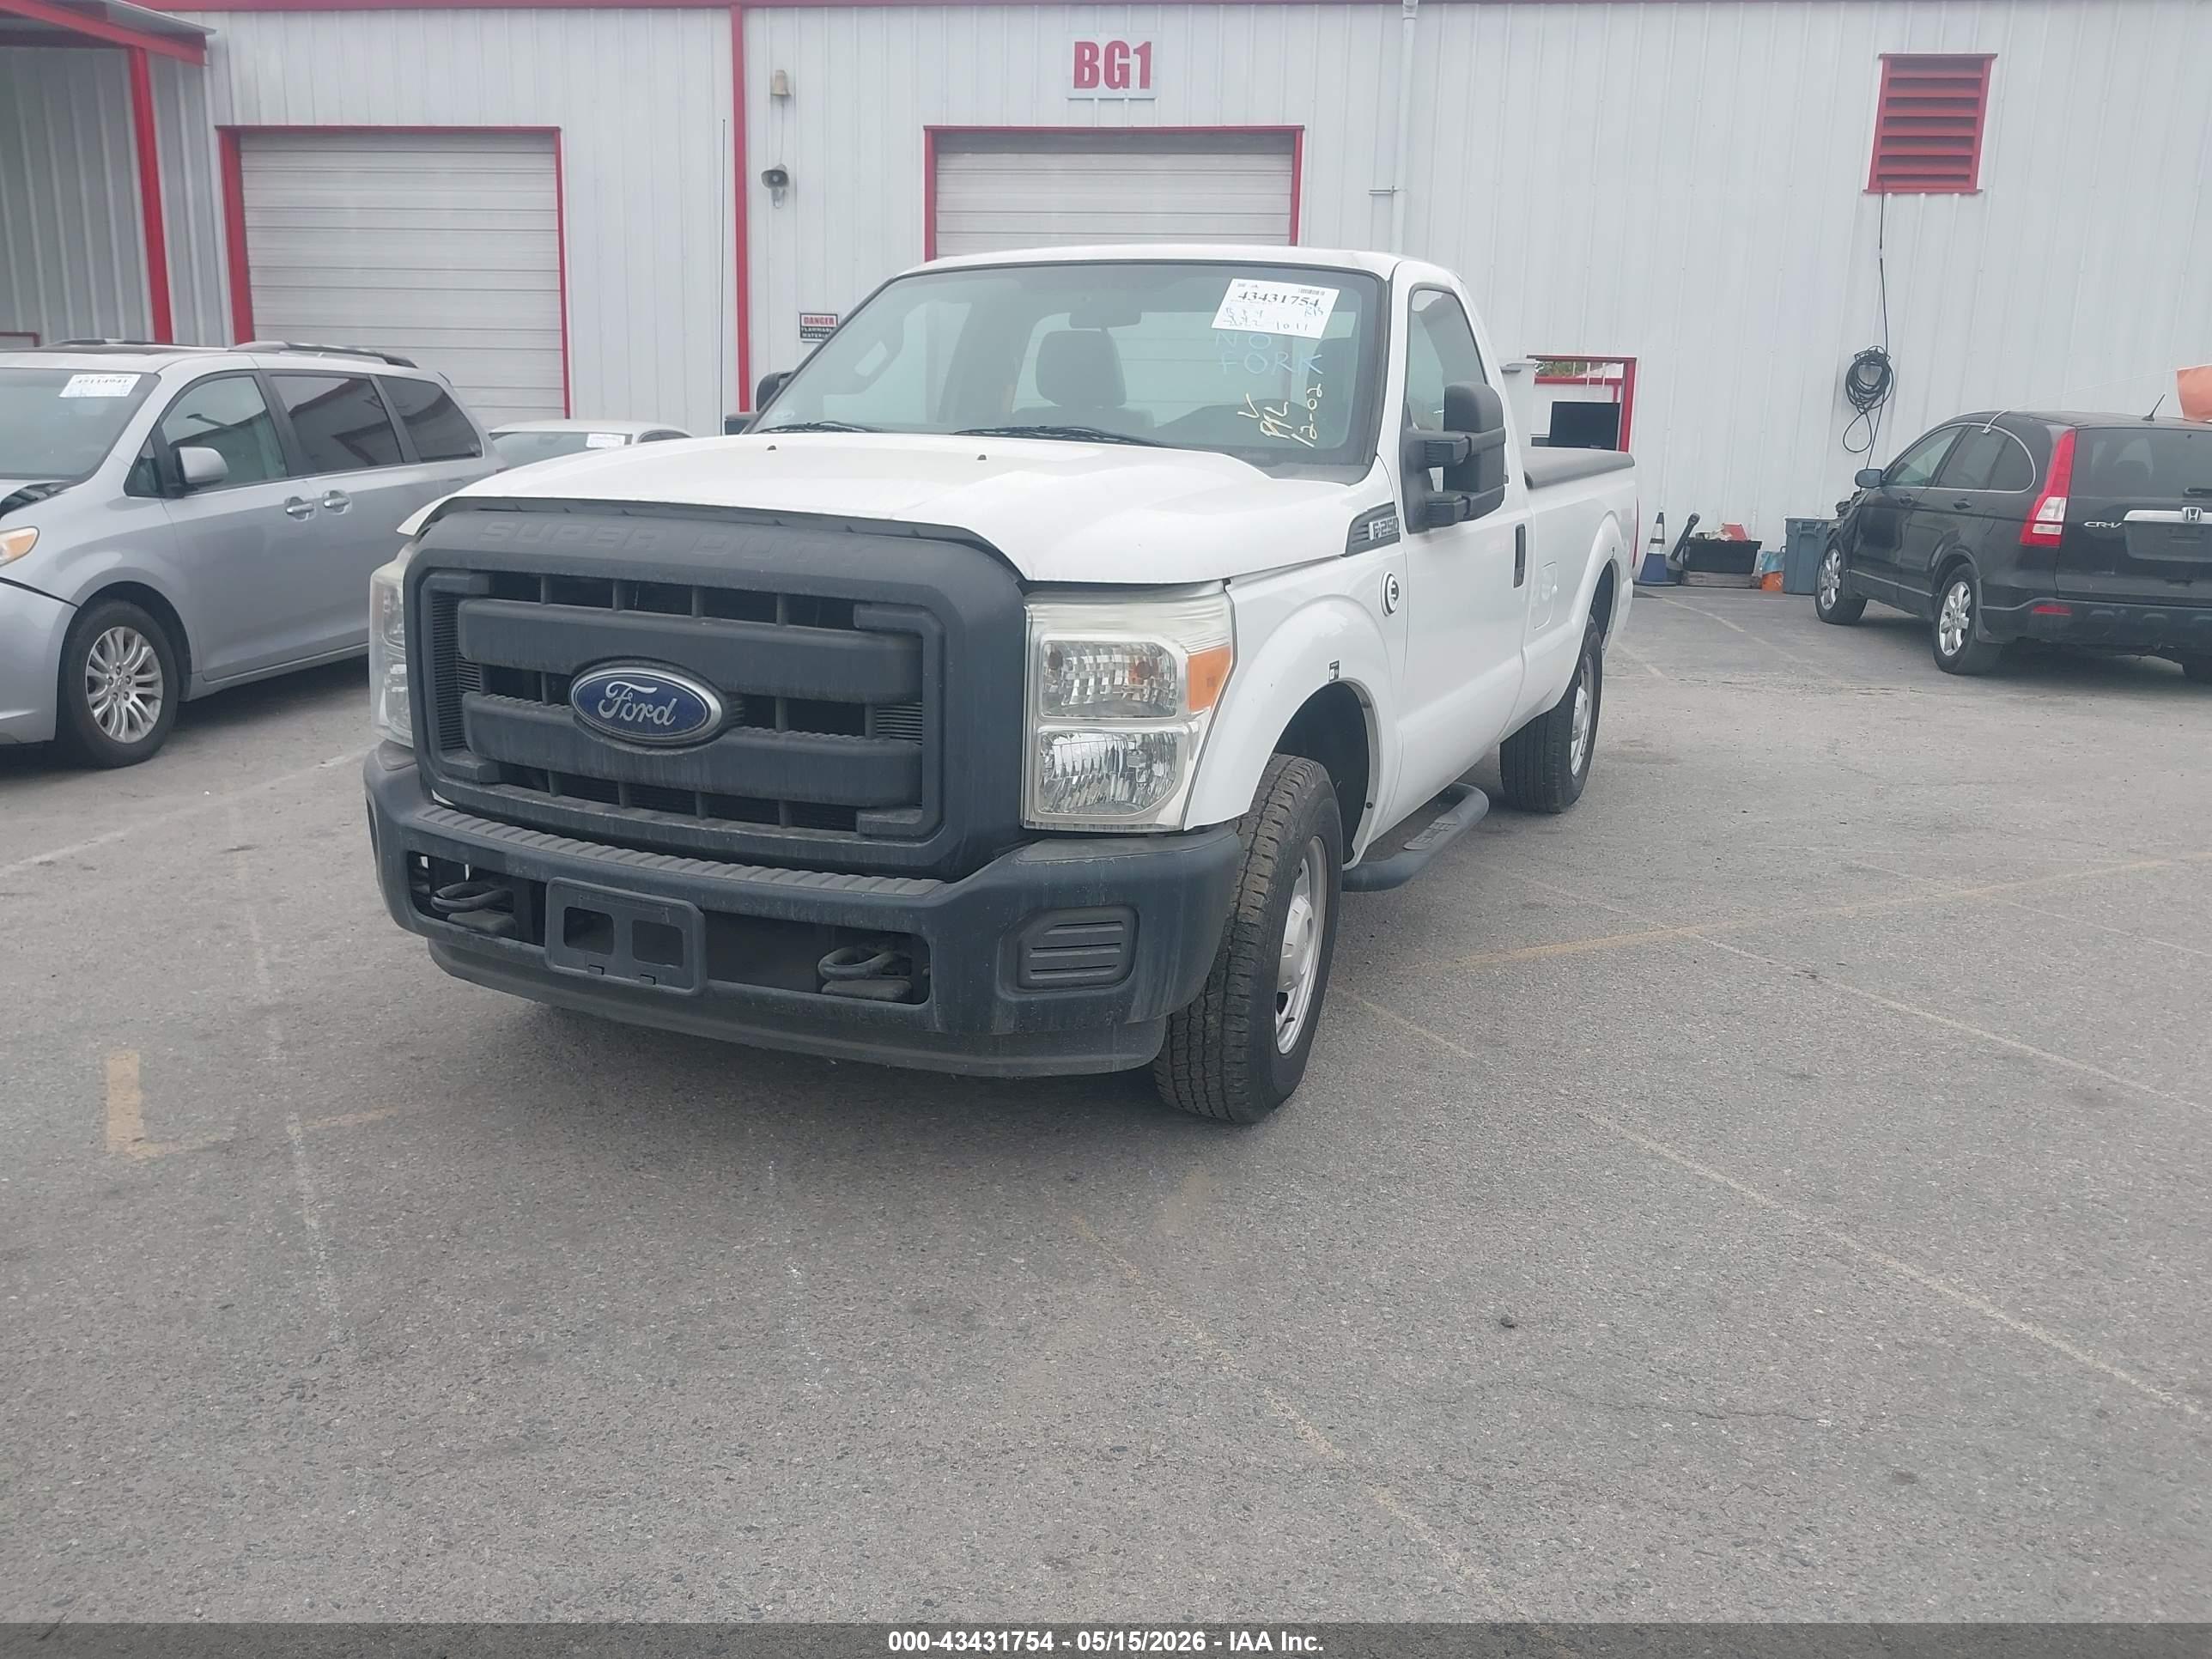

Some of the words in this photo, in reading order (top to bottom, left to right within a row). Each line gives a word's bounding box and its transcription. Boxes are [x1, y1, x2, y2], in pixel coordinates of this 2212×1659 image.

[1073, 40, 1152, 89] BG1
[1237, 290, 1320, 307] 43431754
[803, 316, 834, 325] DANGER
[1216, 331, 1272, 350] NO
[1218, 350, 1323, 375] FORK
[478, 521, 668, 551] SUPER
[691, 532, 872, 565] DUTY
[598, 681, 678, 726] Ford
